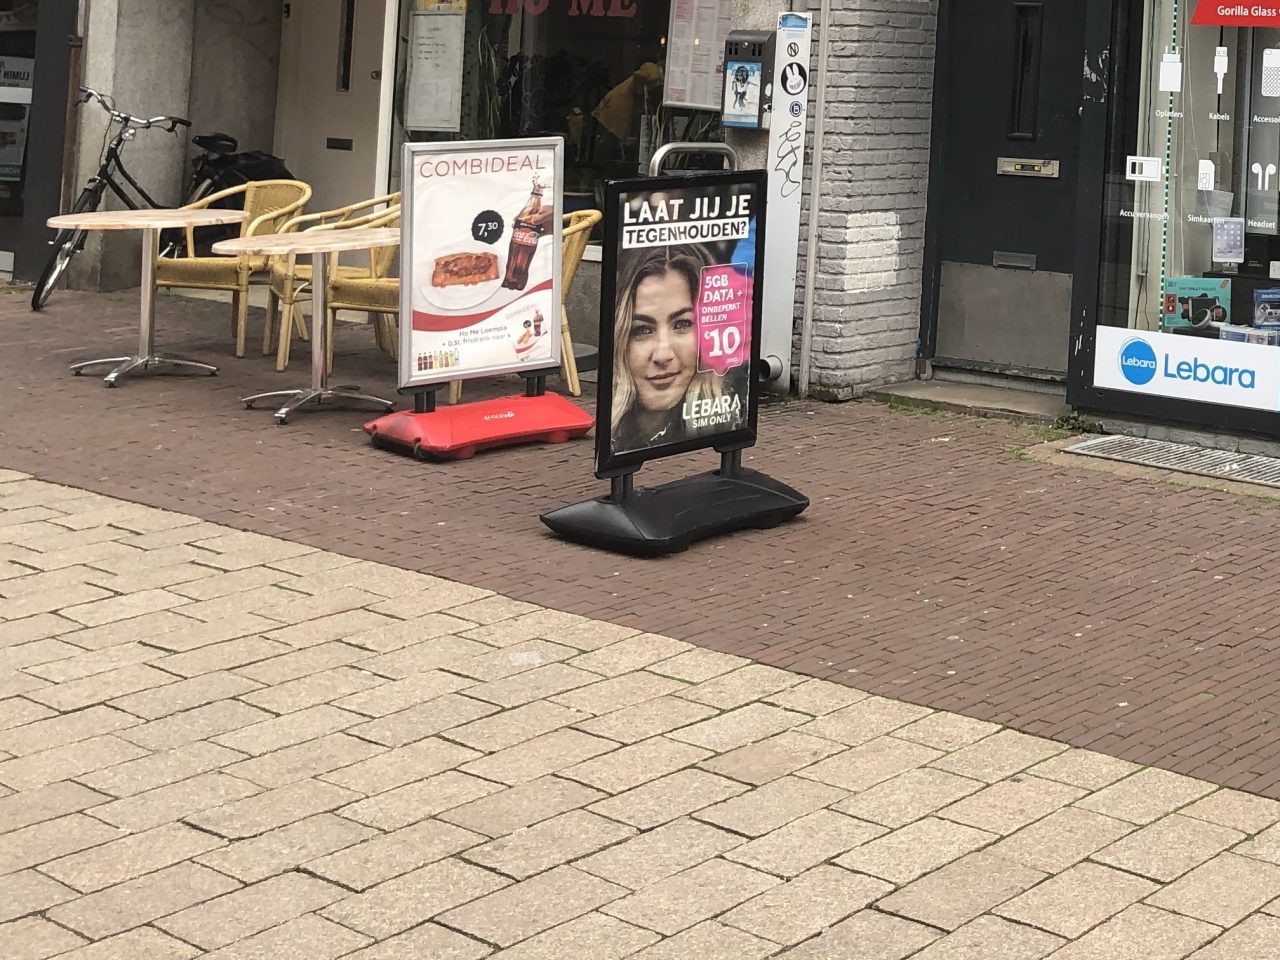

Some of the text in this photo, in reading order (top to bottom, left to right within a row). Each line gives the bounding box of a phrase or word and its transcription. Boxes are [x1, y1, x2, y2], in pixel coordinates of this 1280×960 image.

[1217, 5, 1249, 16] Gorilla
[1251, 6, 1277, 17] Glass
[1155, 109, 1184, 119] Opladers
[1208, 112, 1230, 121] Kabels
[419, 154, 546, 178] COMBIDEAL
[623, 195, 751, 224] LAAT JIJ JE
[1119, 209, 1169, 220] Accu vervangen
[1187, 214, 1225, 224] Simkaarten
[1248, 219, 1276, 229] Headset
[625, 221, 747, 245] TEGENHOUDEN?
[704, 274, 729, 289] 5GB
[703, 288, 734, 303] DATA
[701, 302, 741, 314] ONBEPERKT
[701, 314, 728, 324] BELLEN
[480, 325, 508, 335] Loempia
[1122, 355, 1156, 369] Lebara
[1164, 353, 1256, 389] Lebara
[682, 393, 741, 420] LEBARA
[692, 413, 732, 429] SIM ONLY
